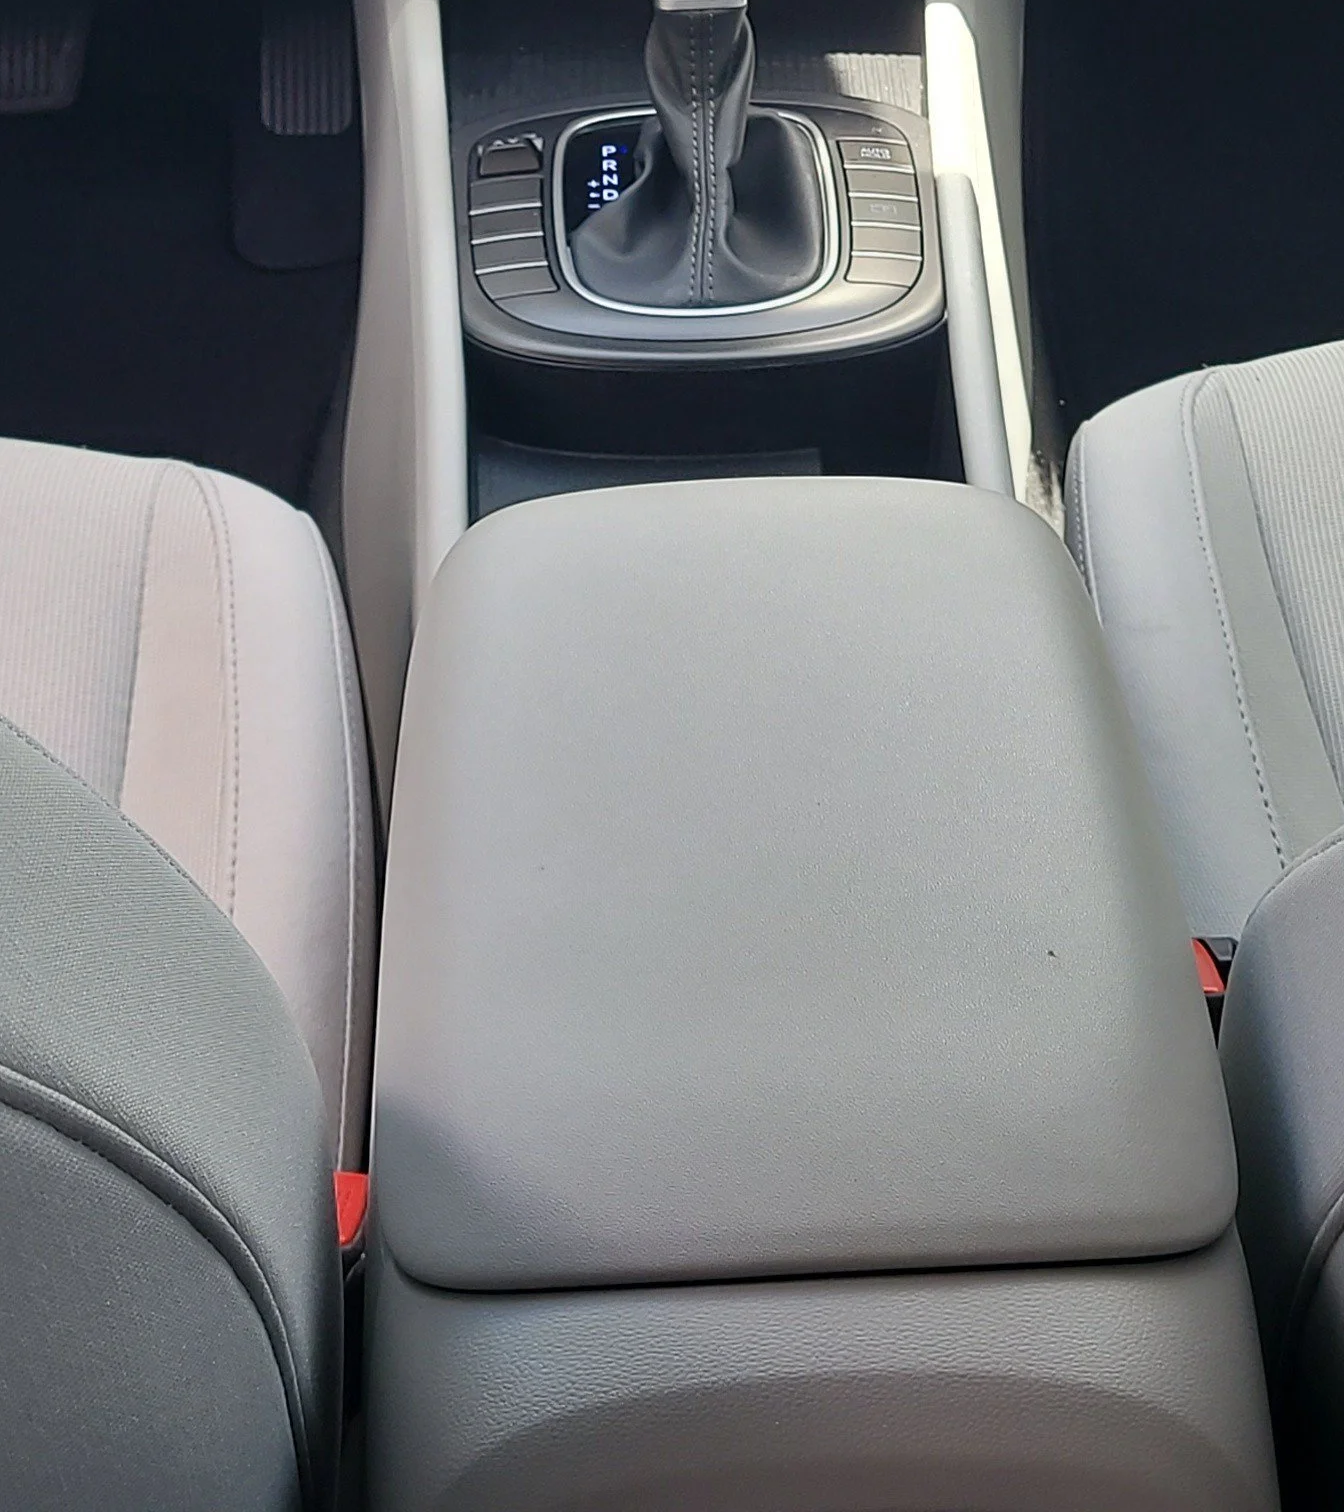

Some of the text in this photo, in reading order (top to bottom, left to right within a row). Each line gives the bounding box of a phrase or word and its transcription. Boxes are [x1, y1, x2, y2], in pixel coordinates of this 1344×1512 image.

[602, 145, 617, 157] P
[602, 159, 617, 171] R
[602, 173, 618, 186] N
[602, 189, 619, 201] D
